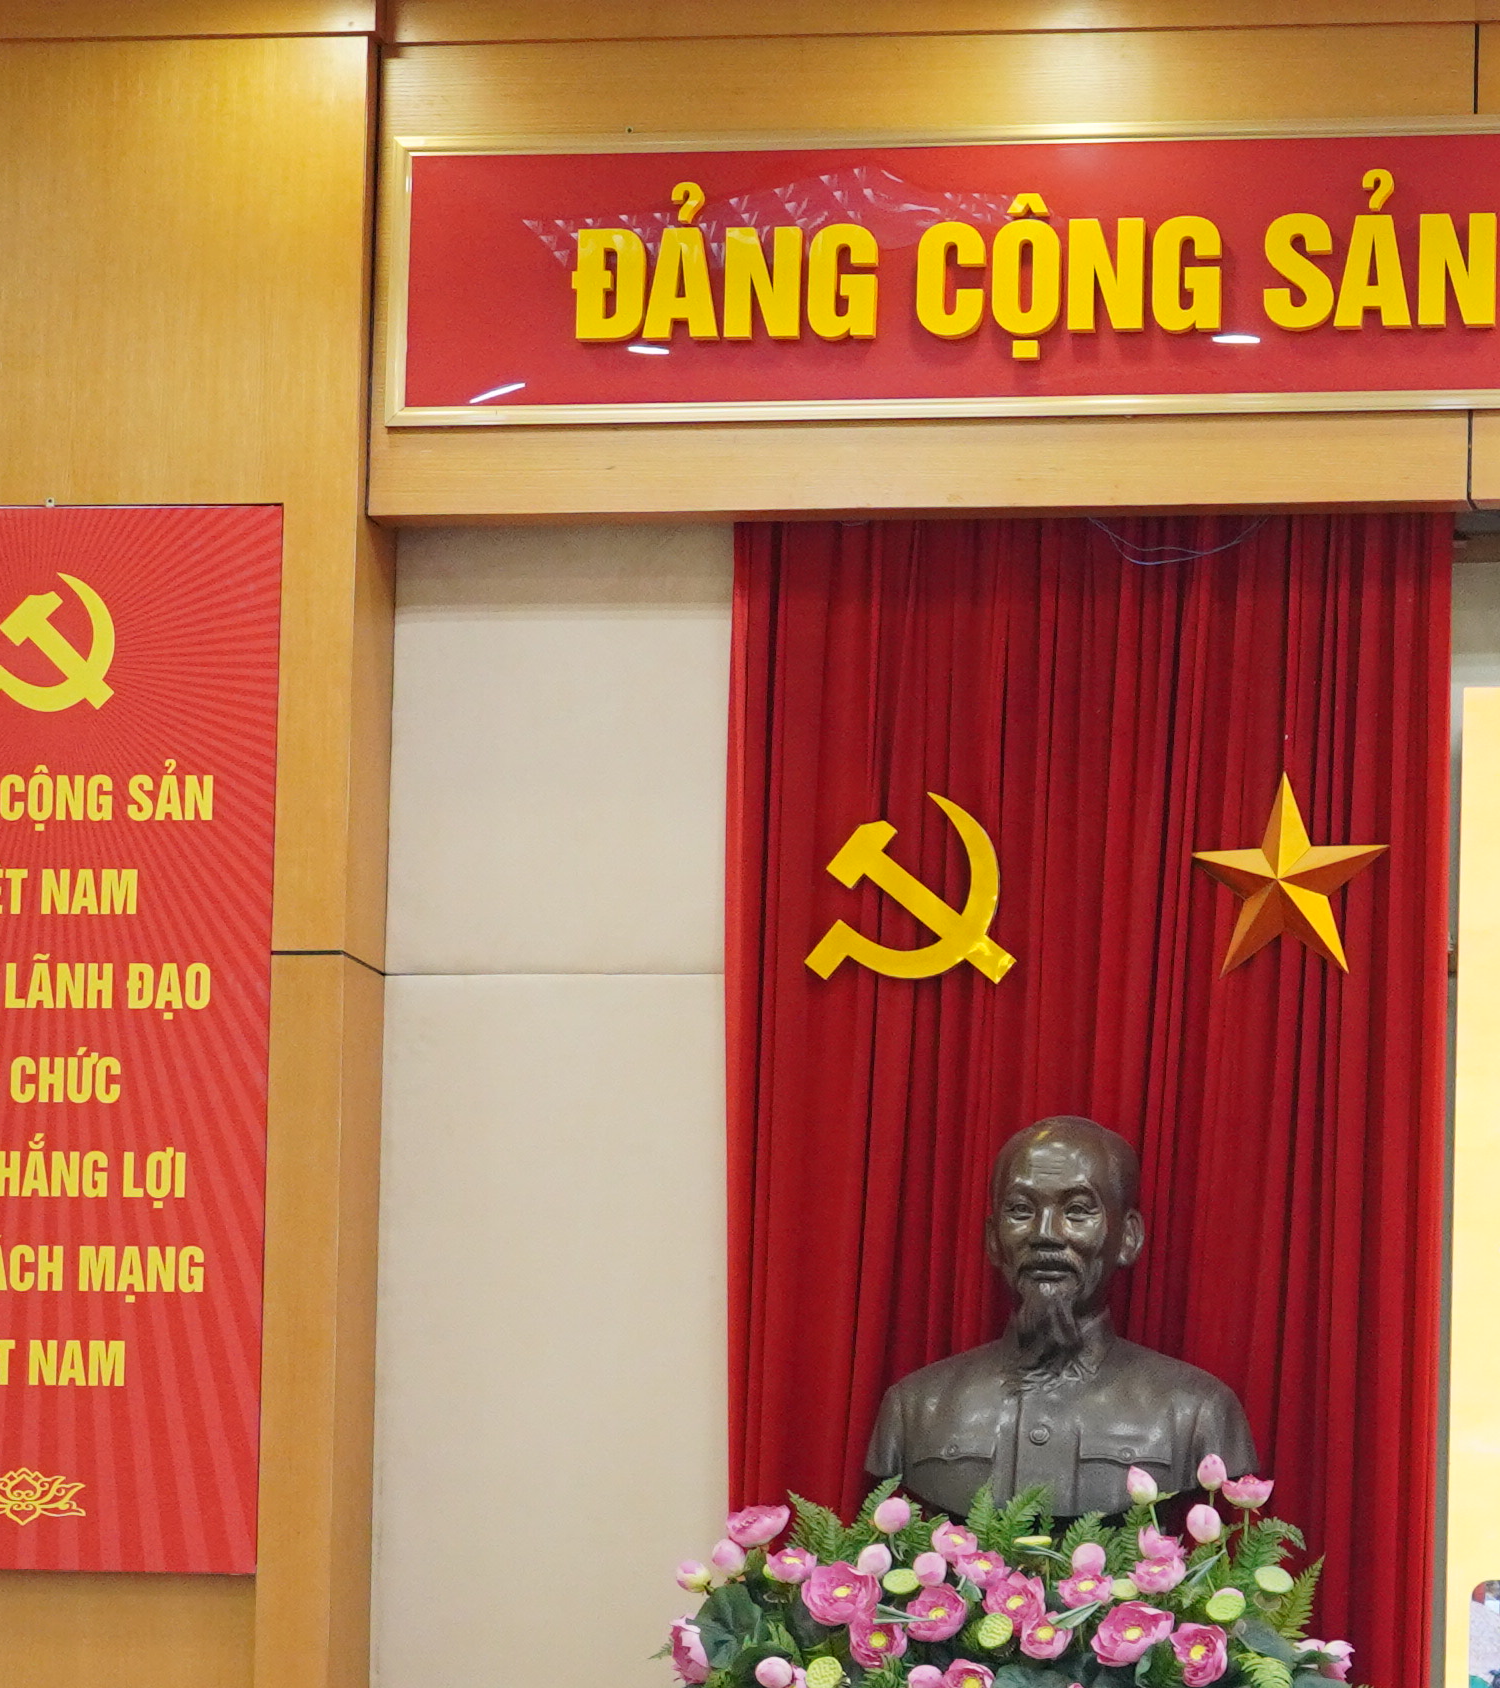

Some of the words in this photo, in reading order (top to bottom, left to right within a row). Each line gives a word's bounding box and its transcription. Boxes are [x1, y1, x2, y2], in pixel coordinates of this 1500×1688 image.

[572, 182, 878, 339] ĐẢNG
[916, 193, 1221, 358] CỘNG
[1264, 169, 1496, 328] SẢN
[0, 765, 112, 831] CỘNG
[128, 759, 212, 821] SẢN
[42, 869, 137, 914] NAM
[5, 954, 112, 1008] LÃNH
[127, 963, 210, 1019] ĐẠO
[11, 1047, 120, 1103] CHỨC
[123, 1147, 185, 1208] LỢI
[79, 1246, 203, 1302] MẠNG
[29, 1340, 124, 1386] NAM
